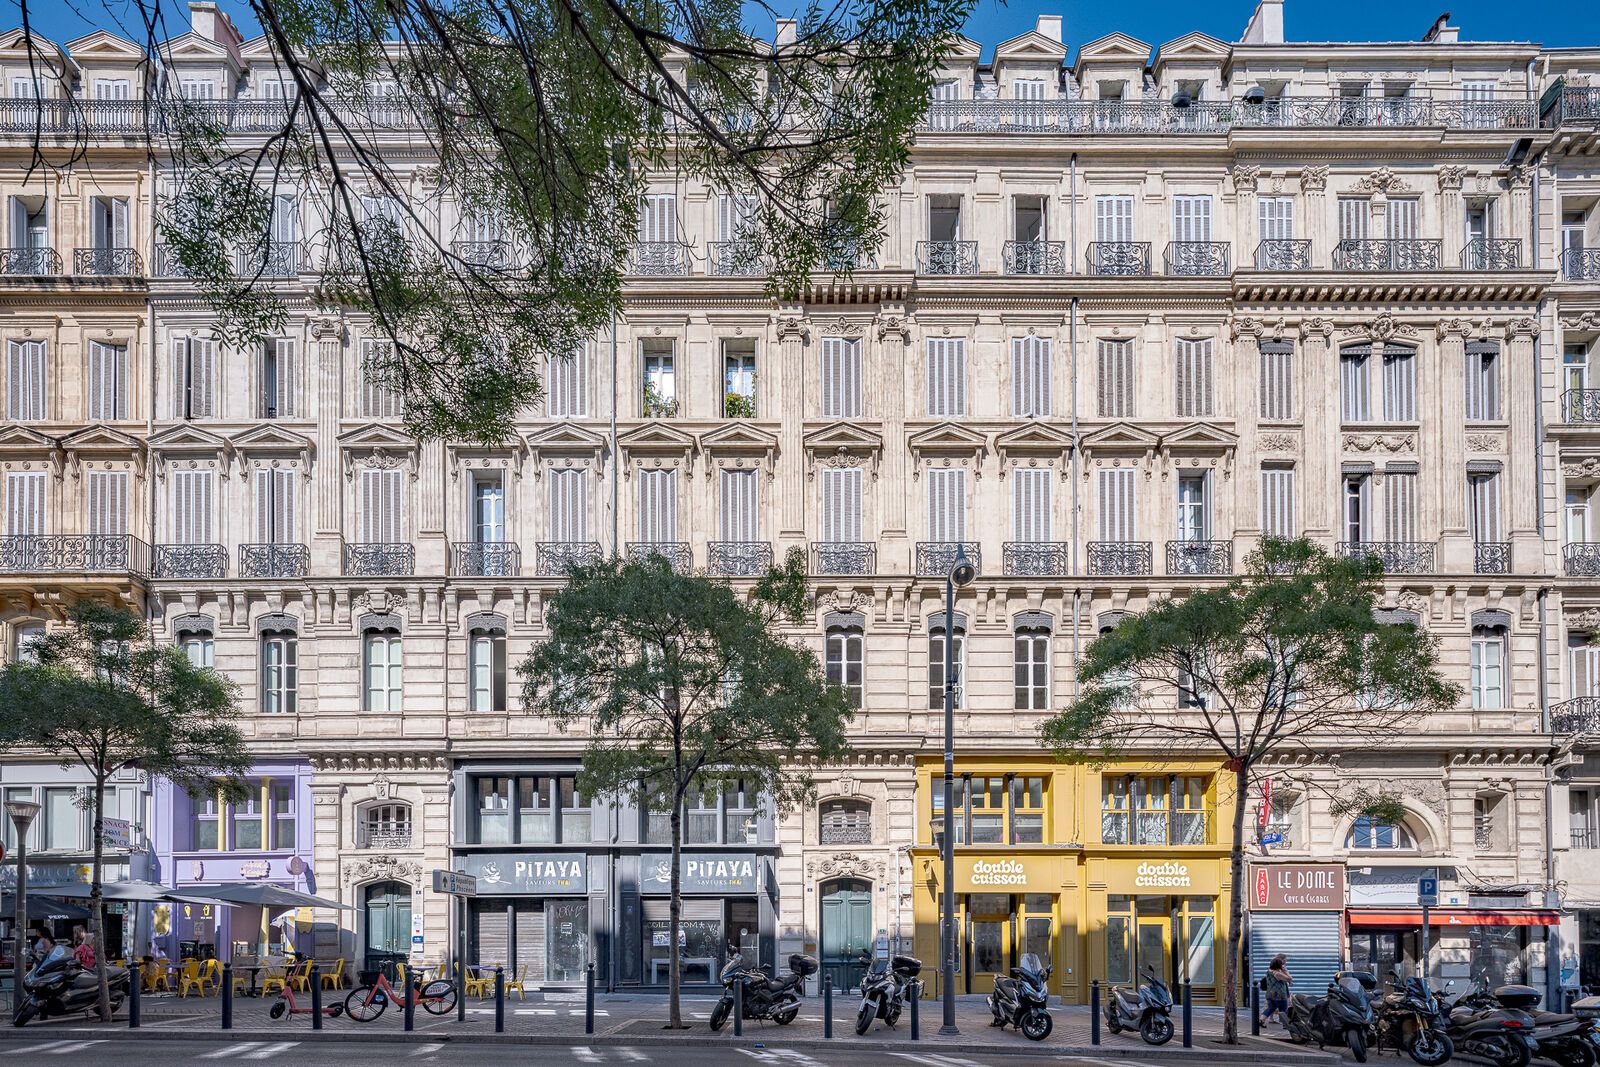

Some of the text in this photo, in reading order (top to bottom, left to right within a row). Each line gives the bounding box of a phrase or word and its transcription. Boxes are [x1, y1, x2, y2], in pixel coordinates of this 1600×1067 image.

[103, 820, 128, 829] SNACK
[973, 860, 1024, 873] double
[1137, 861, 1188, 875] double
[971, 872, 1027, 885] cuisson
[1135, 874, 1191, 887] cuisson
[1278, 871, 1292, 889] LE
[1297, 870, 1335, 889] DOME
[1424, 881, 1433, 893] P
